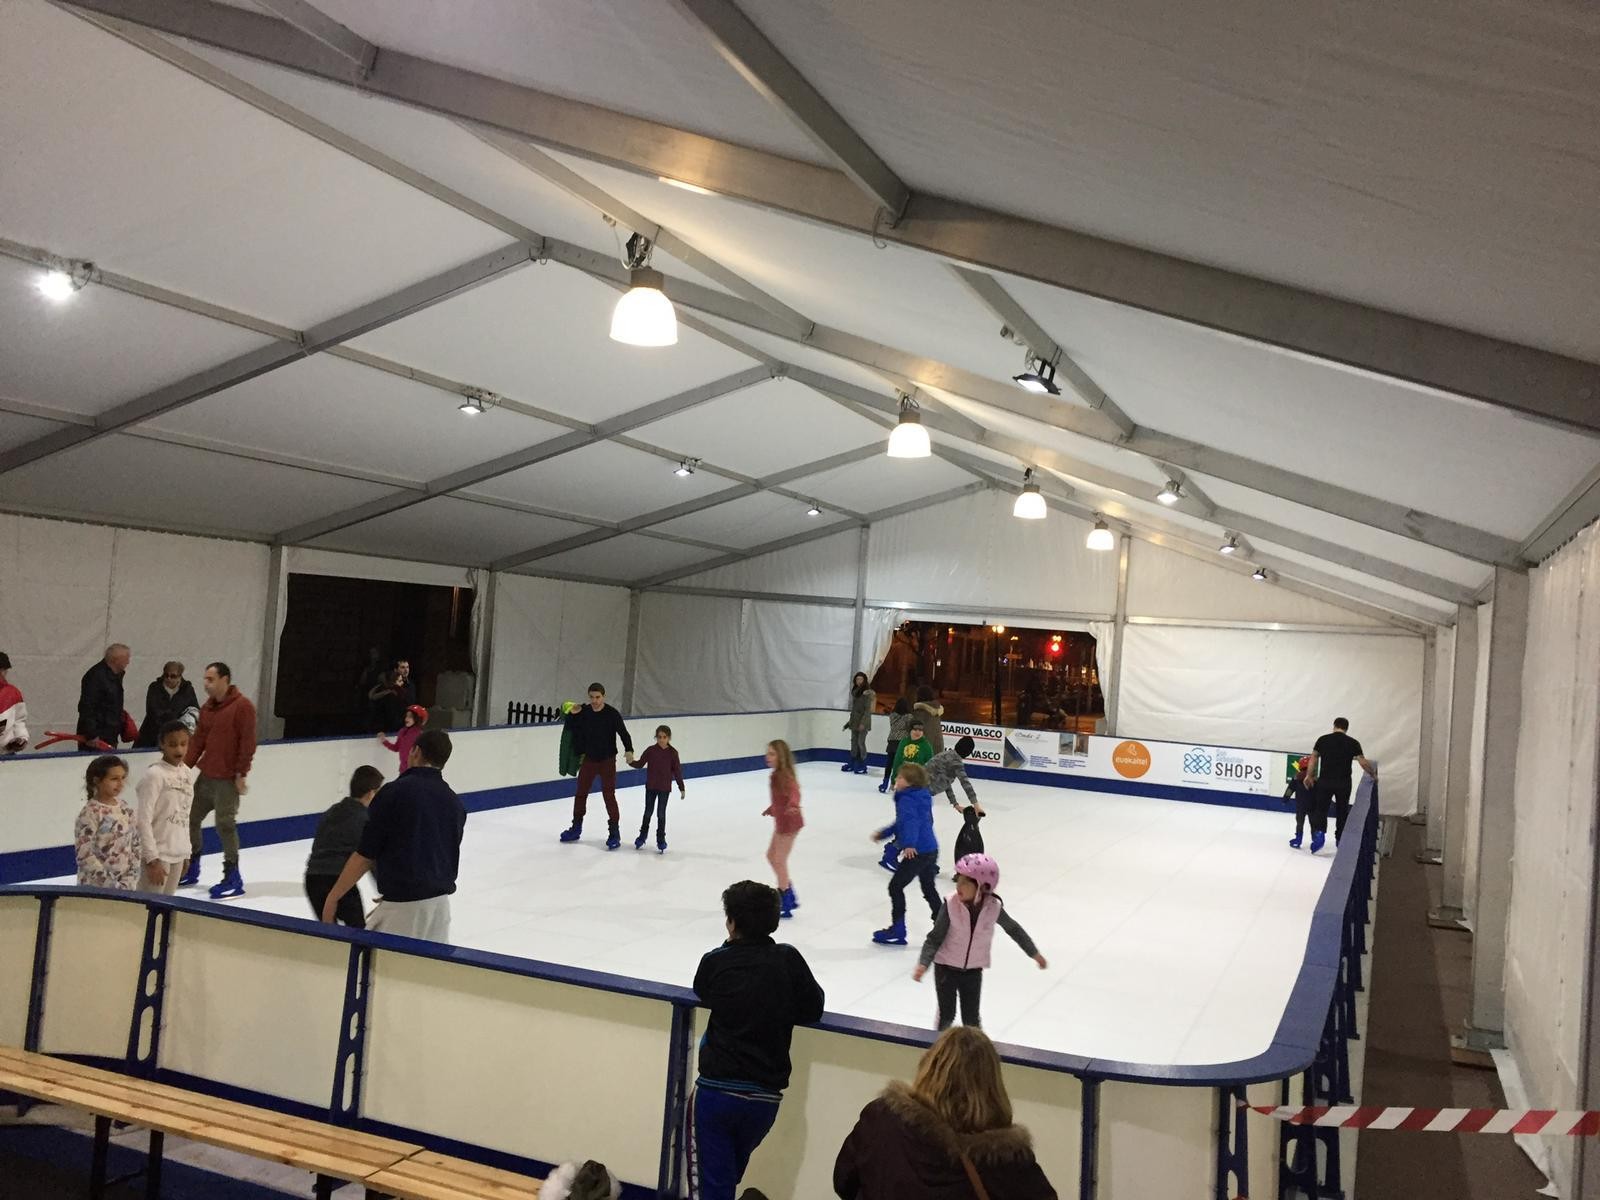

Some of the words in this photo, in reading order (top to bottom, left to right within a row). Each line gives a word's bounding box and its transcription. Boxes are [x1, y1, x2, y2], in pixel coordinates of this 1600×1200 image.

[972, 727, 1002, 738] VASCO
[971, 750, 1000, 760] VASCO
[1214, 762, 1262, 780] SHOPS
